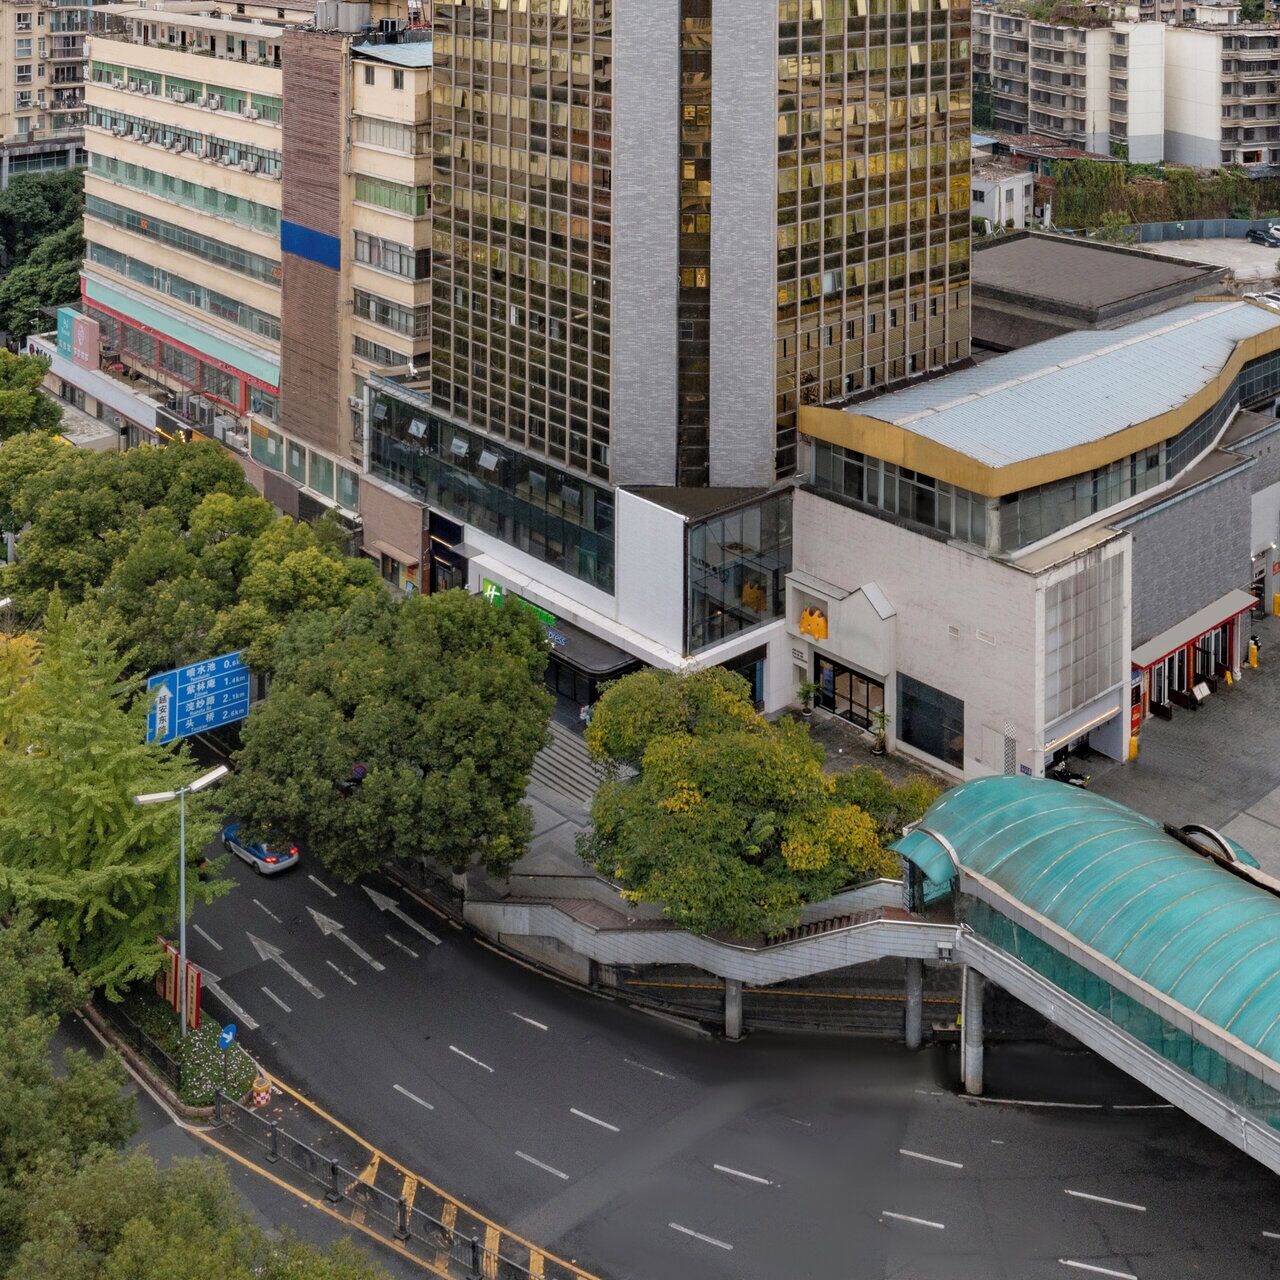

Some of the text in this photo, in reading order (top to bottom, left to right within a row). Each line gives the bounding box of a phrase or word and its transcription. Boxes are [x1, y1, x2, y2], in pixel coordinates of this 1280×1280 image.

[186, 659, 240, 678] 喷水池 0.6k
[186, 675, 246, 695] 紫林庵 1.4km
[223, 692, 245, 703] 2.1km
[222, 709, 245, 720] 2.6km
